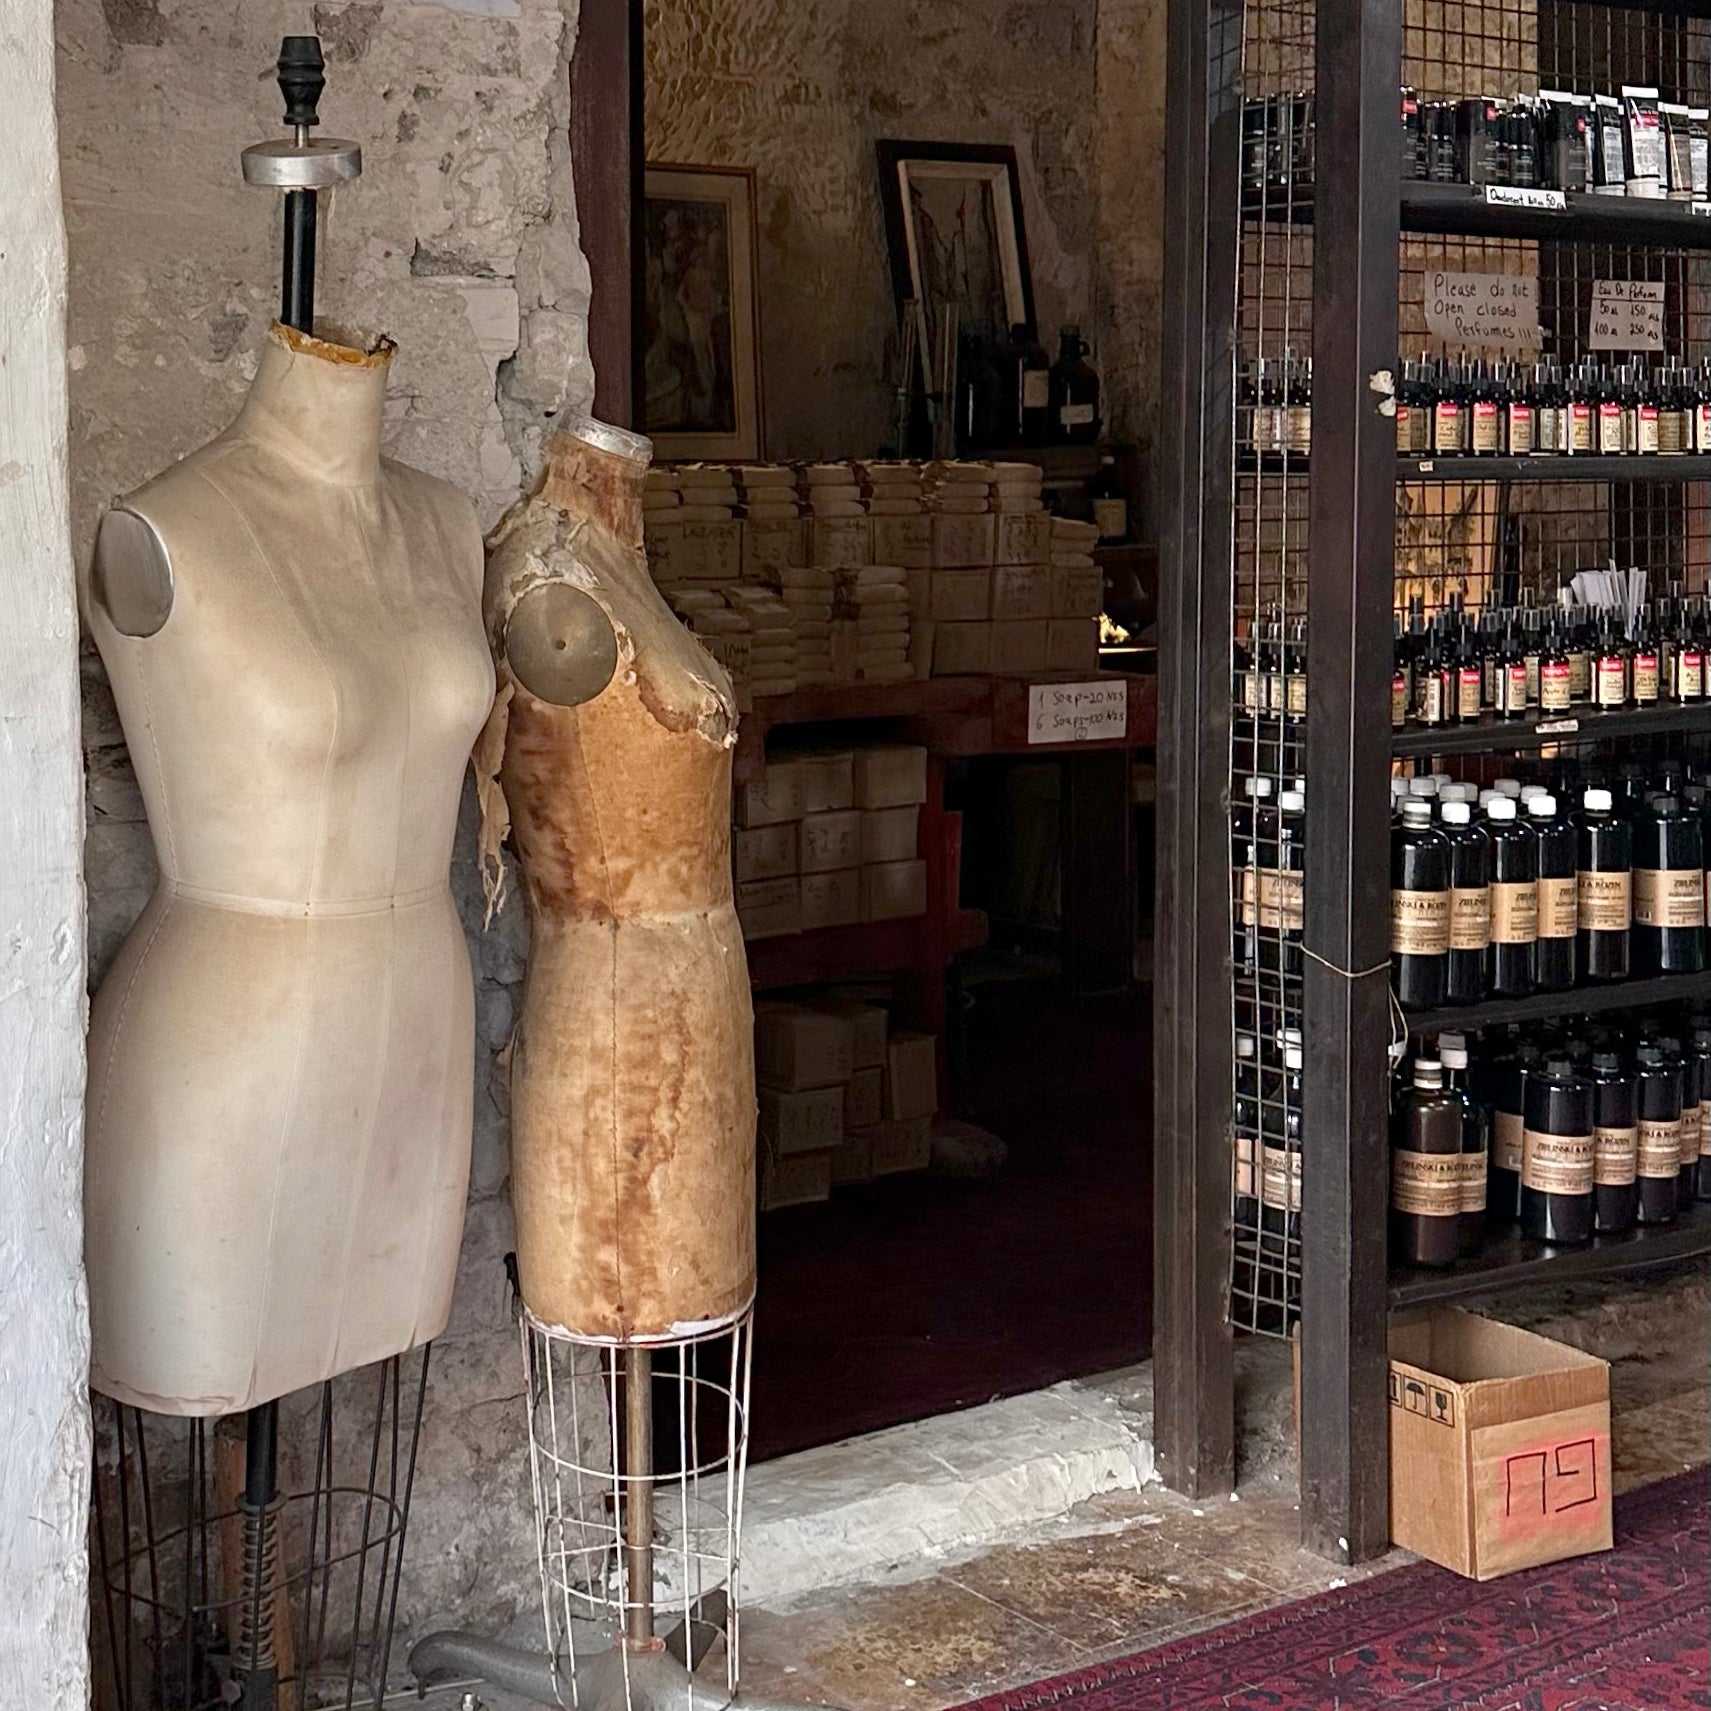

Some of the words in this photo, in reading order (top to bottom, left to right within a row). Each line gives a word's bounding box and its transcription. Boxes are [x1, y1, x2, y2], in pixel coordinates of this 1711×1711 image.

[1434, 273, 1477, 297] Please
[1489, 276, 1505, 297] do
[1434, 299, 1465, 319] Open
[1476, 302, 1517, 318] closed
[1630, 303, 1646, 317] 150
[1454, 316, 1515, 339] Perfumes
[1594, 321, 1609, 336] 100
[1629, 322, 1645, 336] 250
[1036, 713, 1049, 730] 6
